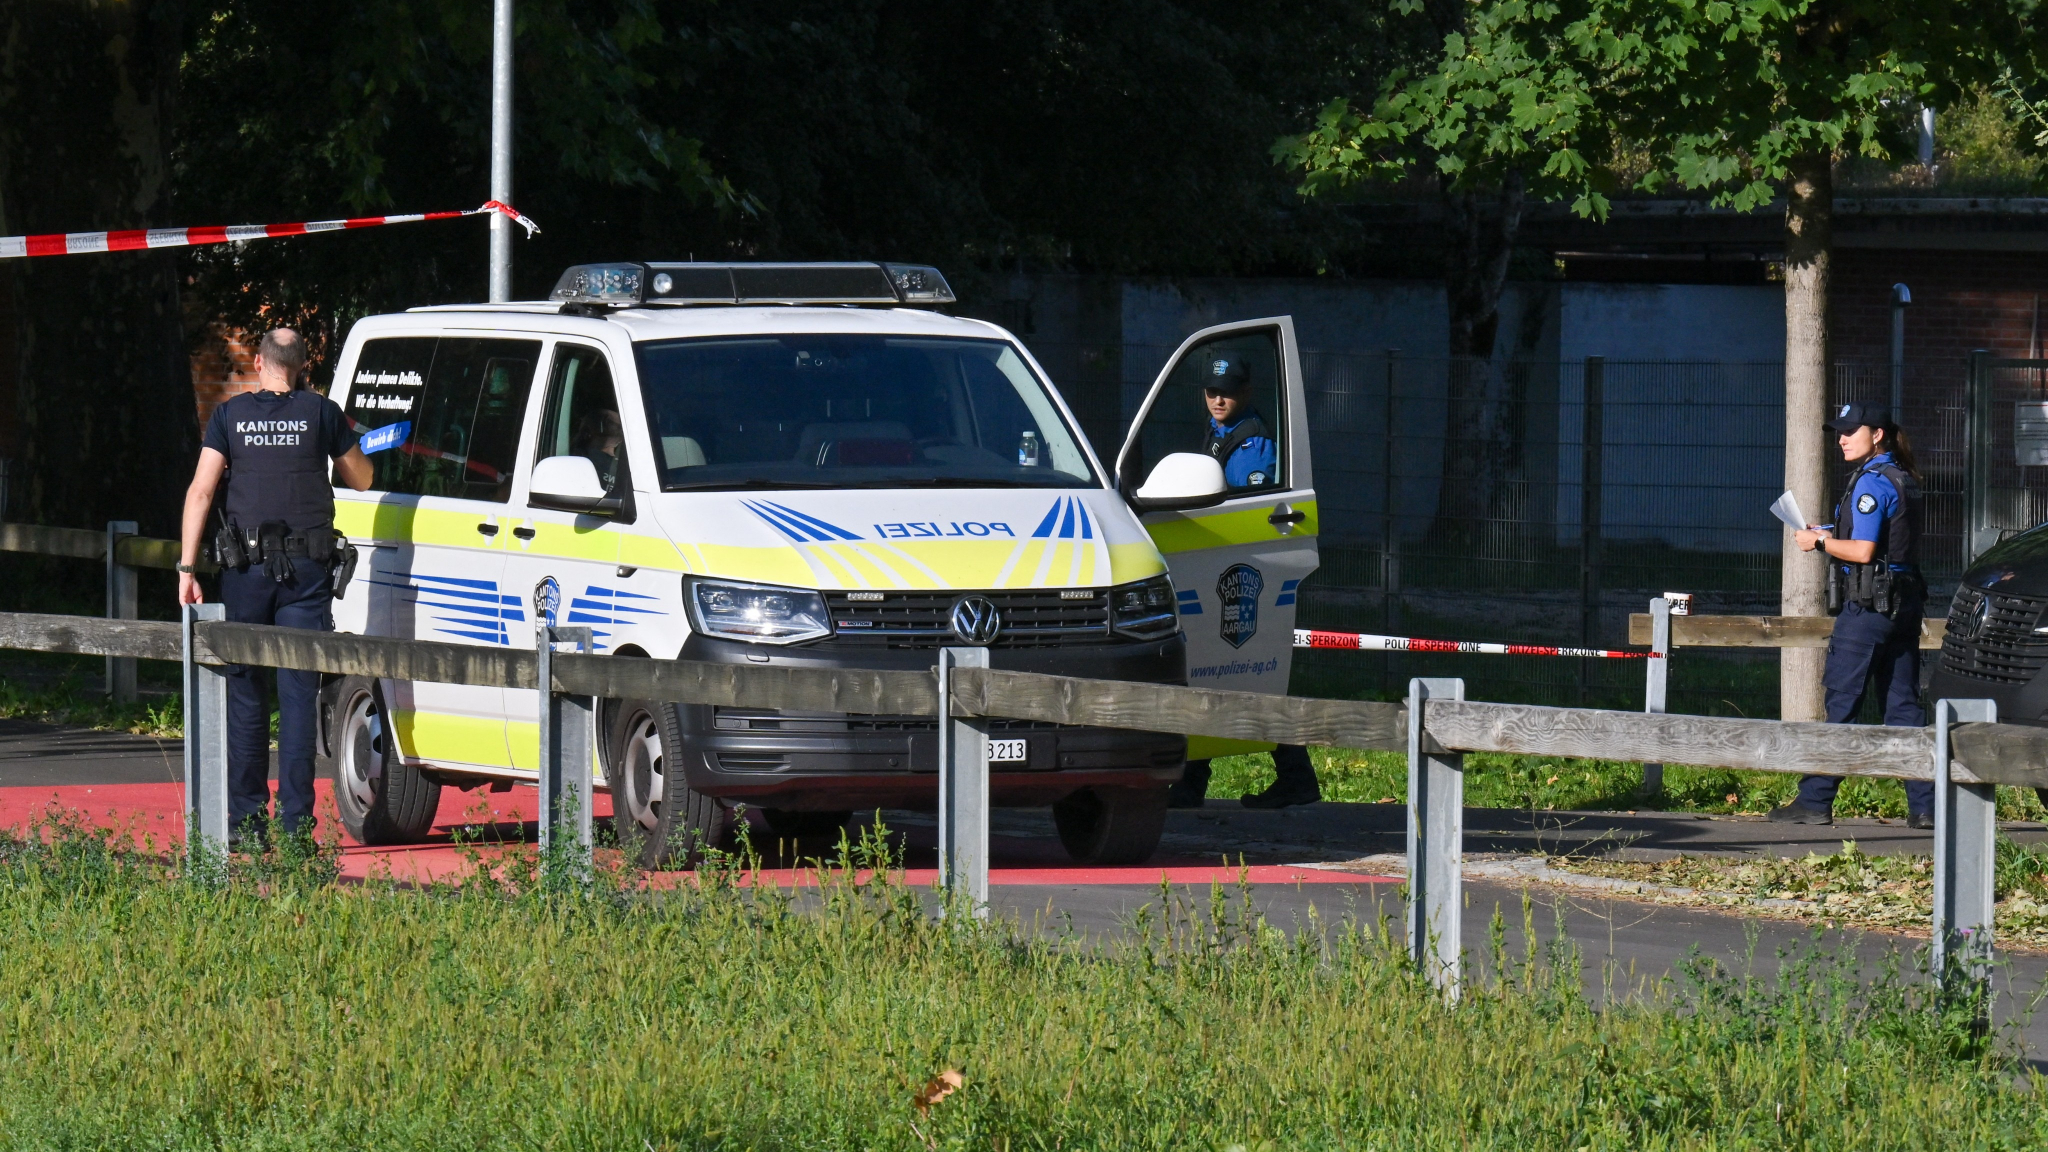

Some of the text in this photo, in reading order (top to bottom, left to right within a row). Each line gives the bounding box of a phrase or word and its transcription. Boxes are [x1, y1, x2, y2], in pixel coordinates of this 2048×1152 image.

[355, 370, 423, 388] Andere planen Delikte.
[355, 394, 414, 414] Wir die Verhaftung!
[236, 420, 308, 433] KANTONS
[244, 434, 300, 447] POLIZEI
[366, 427, 402, 449] Bewirb dich!
[1220, 571, 1260, 593] KANTONS
[535, 584, 559, 604] KANTONS
[1224, 586, 1257, 602] POLIZEI
[1223, 620, 1256, 635] AARGAU
[1385, 638, 1482, 652] POLIZEI-SPERRZONE
[1190, 657, 1278, 679] www.polizei-ag.ch
